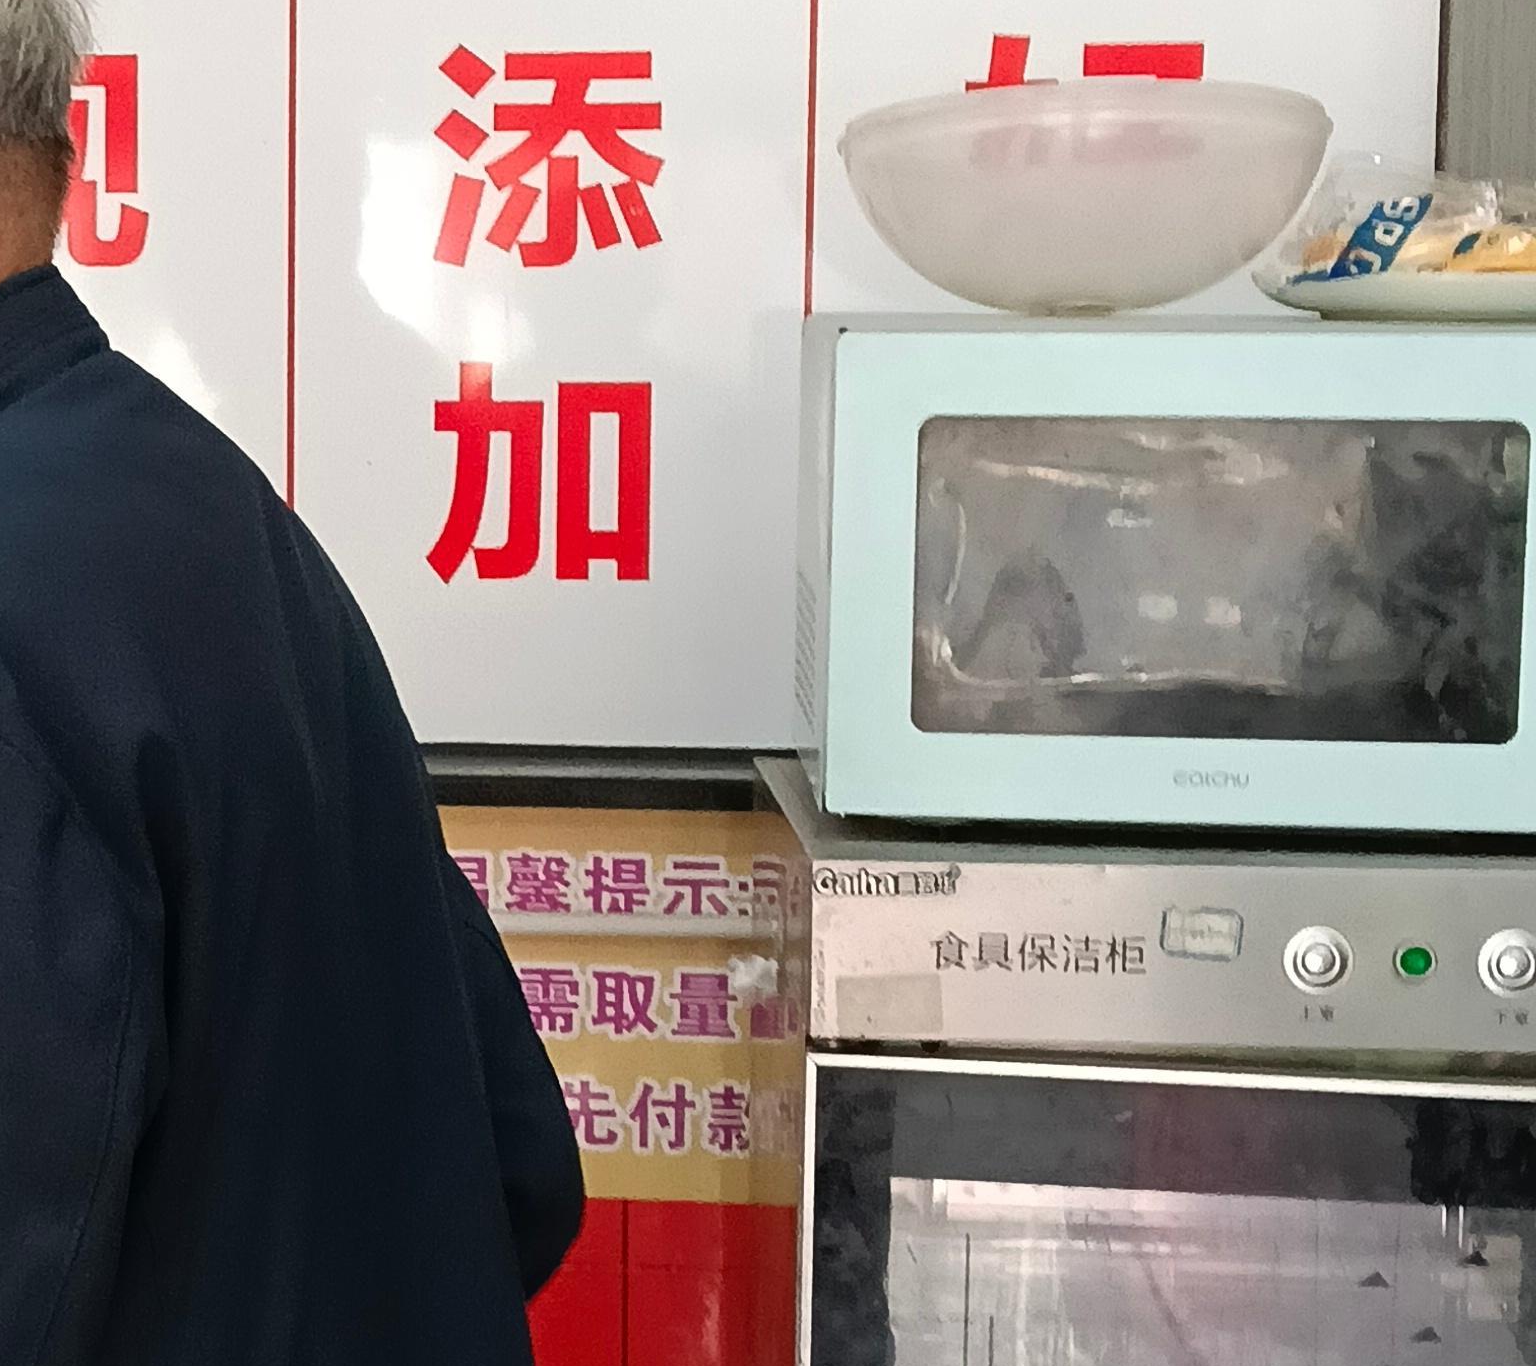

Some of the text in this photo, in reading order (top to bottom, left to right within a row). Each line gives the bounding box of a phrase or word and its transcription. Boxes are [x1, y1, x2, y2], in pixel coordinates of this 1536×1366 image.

[930, 931, 1147, 975] 食具保洁柜
